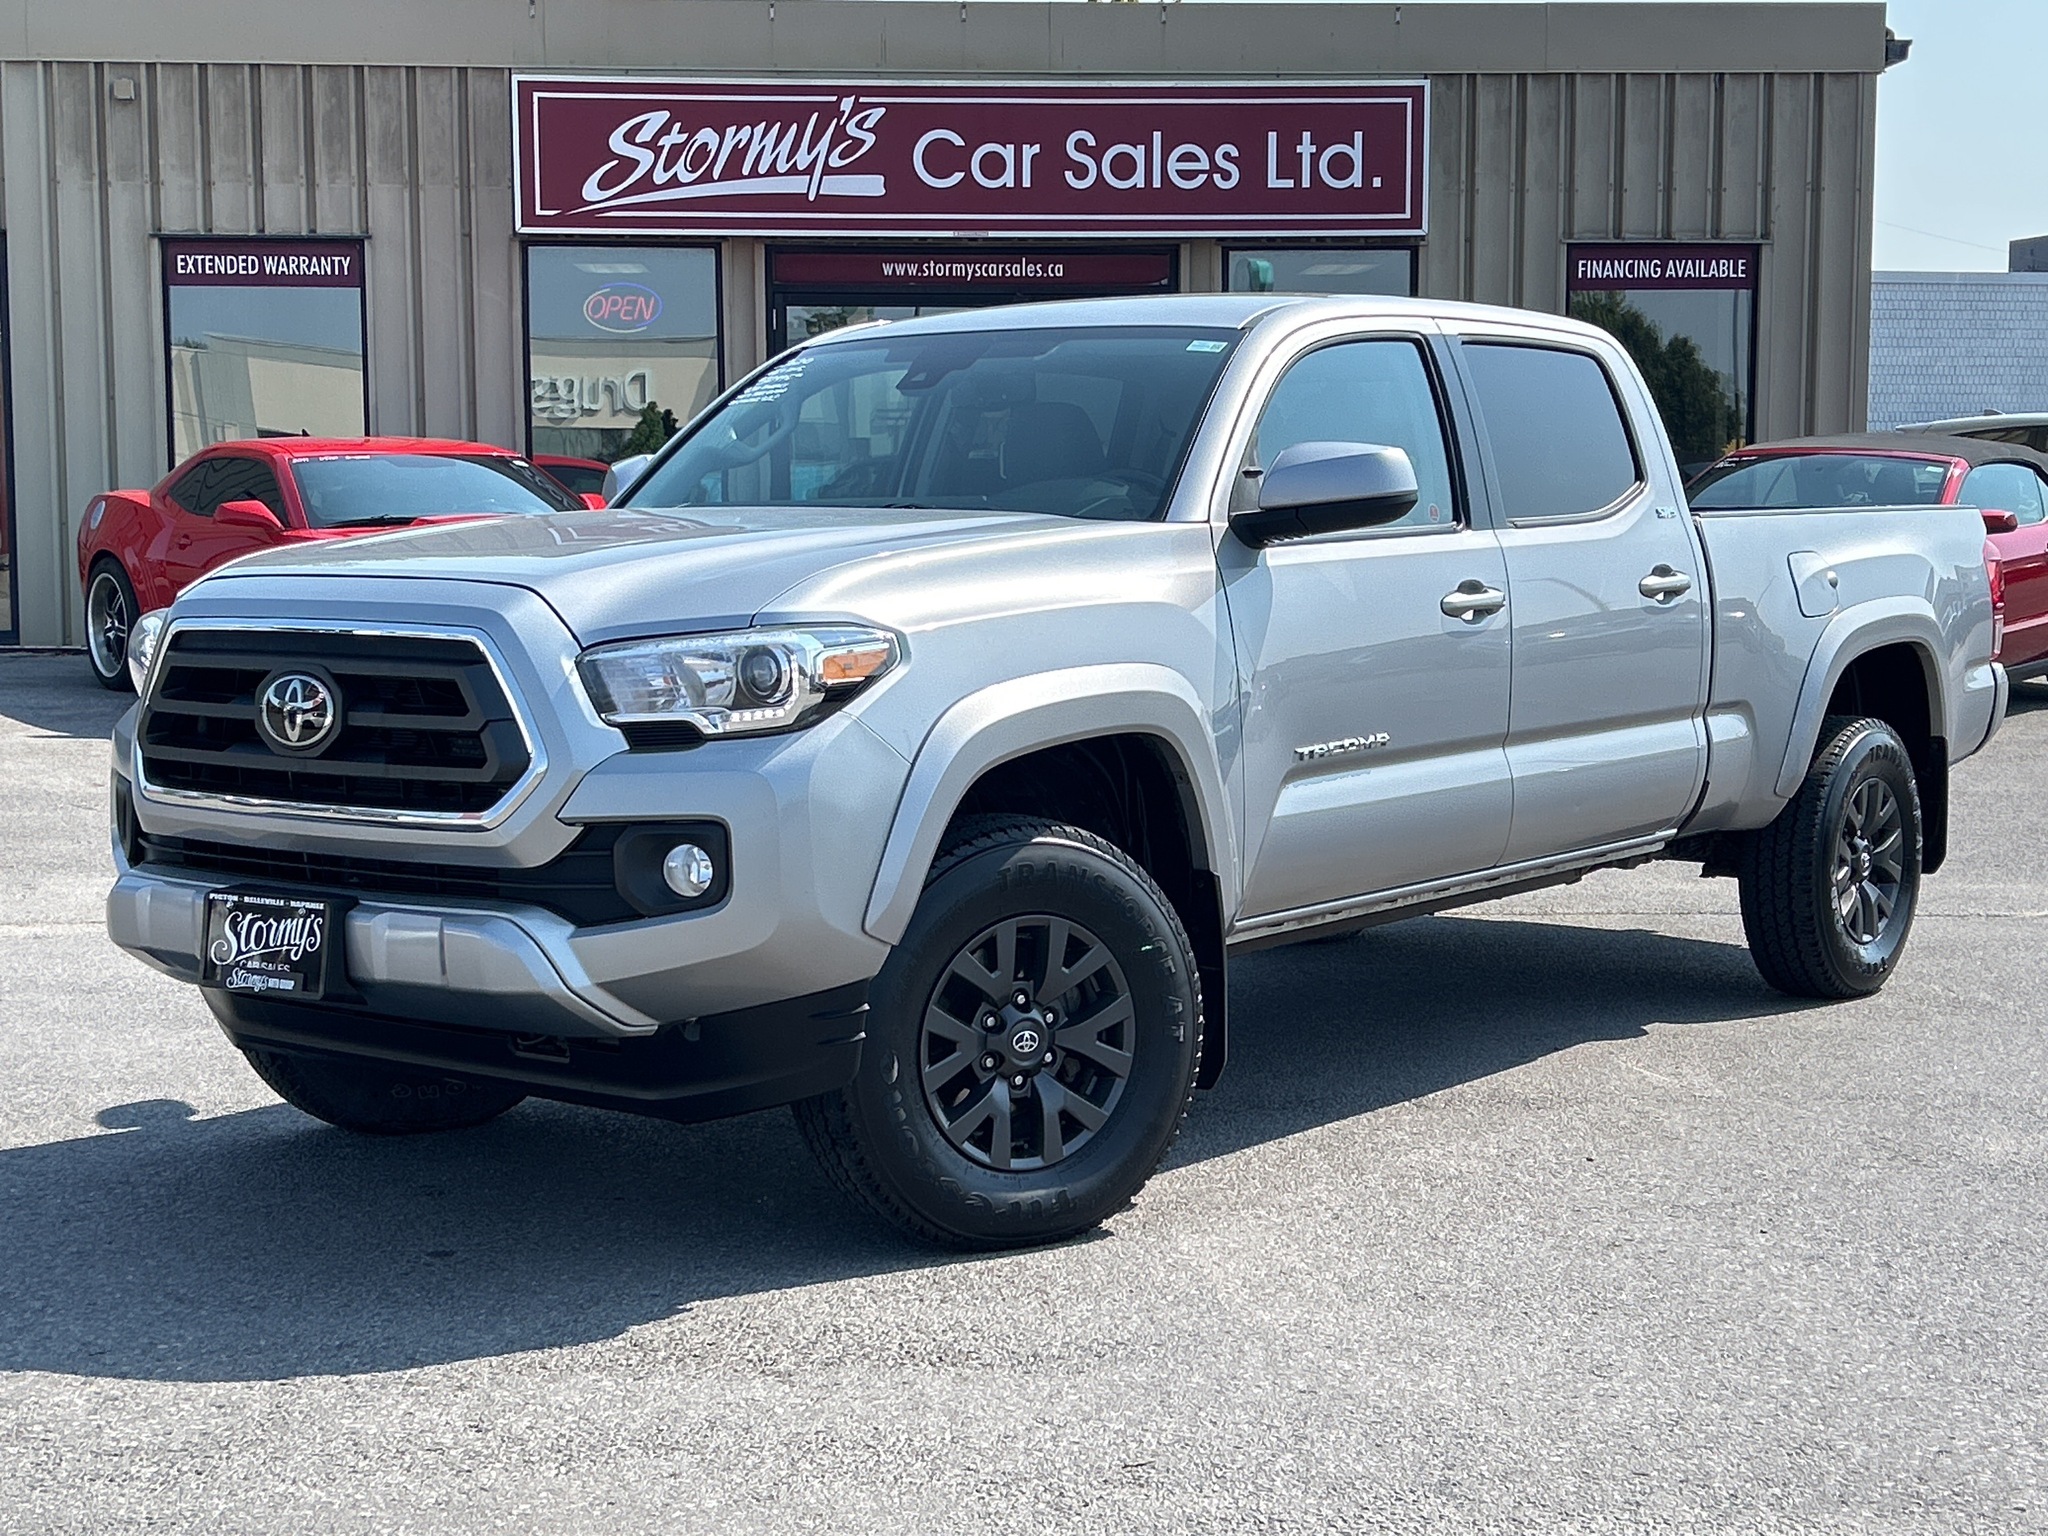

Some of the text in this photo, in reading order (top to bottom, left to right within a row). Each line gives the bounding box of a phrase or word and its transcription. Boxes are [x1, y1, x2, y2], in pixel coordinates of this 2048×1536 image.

[582, 95, 1382, 202] Stormy's Car Sales Ltd.
[176, 254, 351, 276] EXTENDED WARRANTY
[881, 256, 1064, 282] www.stormyscarsales.ca
[1577, 258, 1747, 279] FINANCING AVAILABLE
[587, 295, 655, 321] OPEN
[1294, 731, 1391, 762] TACOMA
[210, 911, 323, 965] Stormy's
